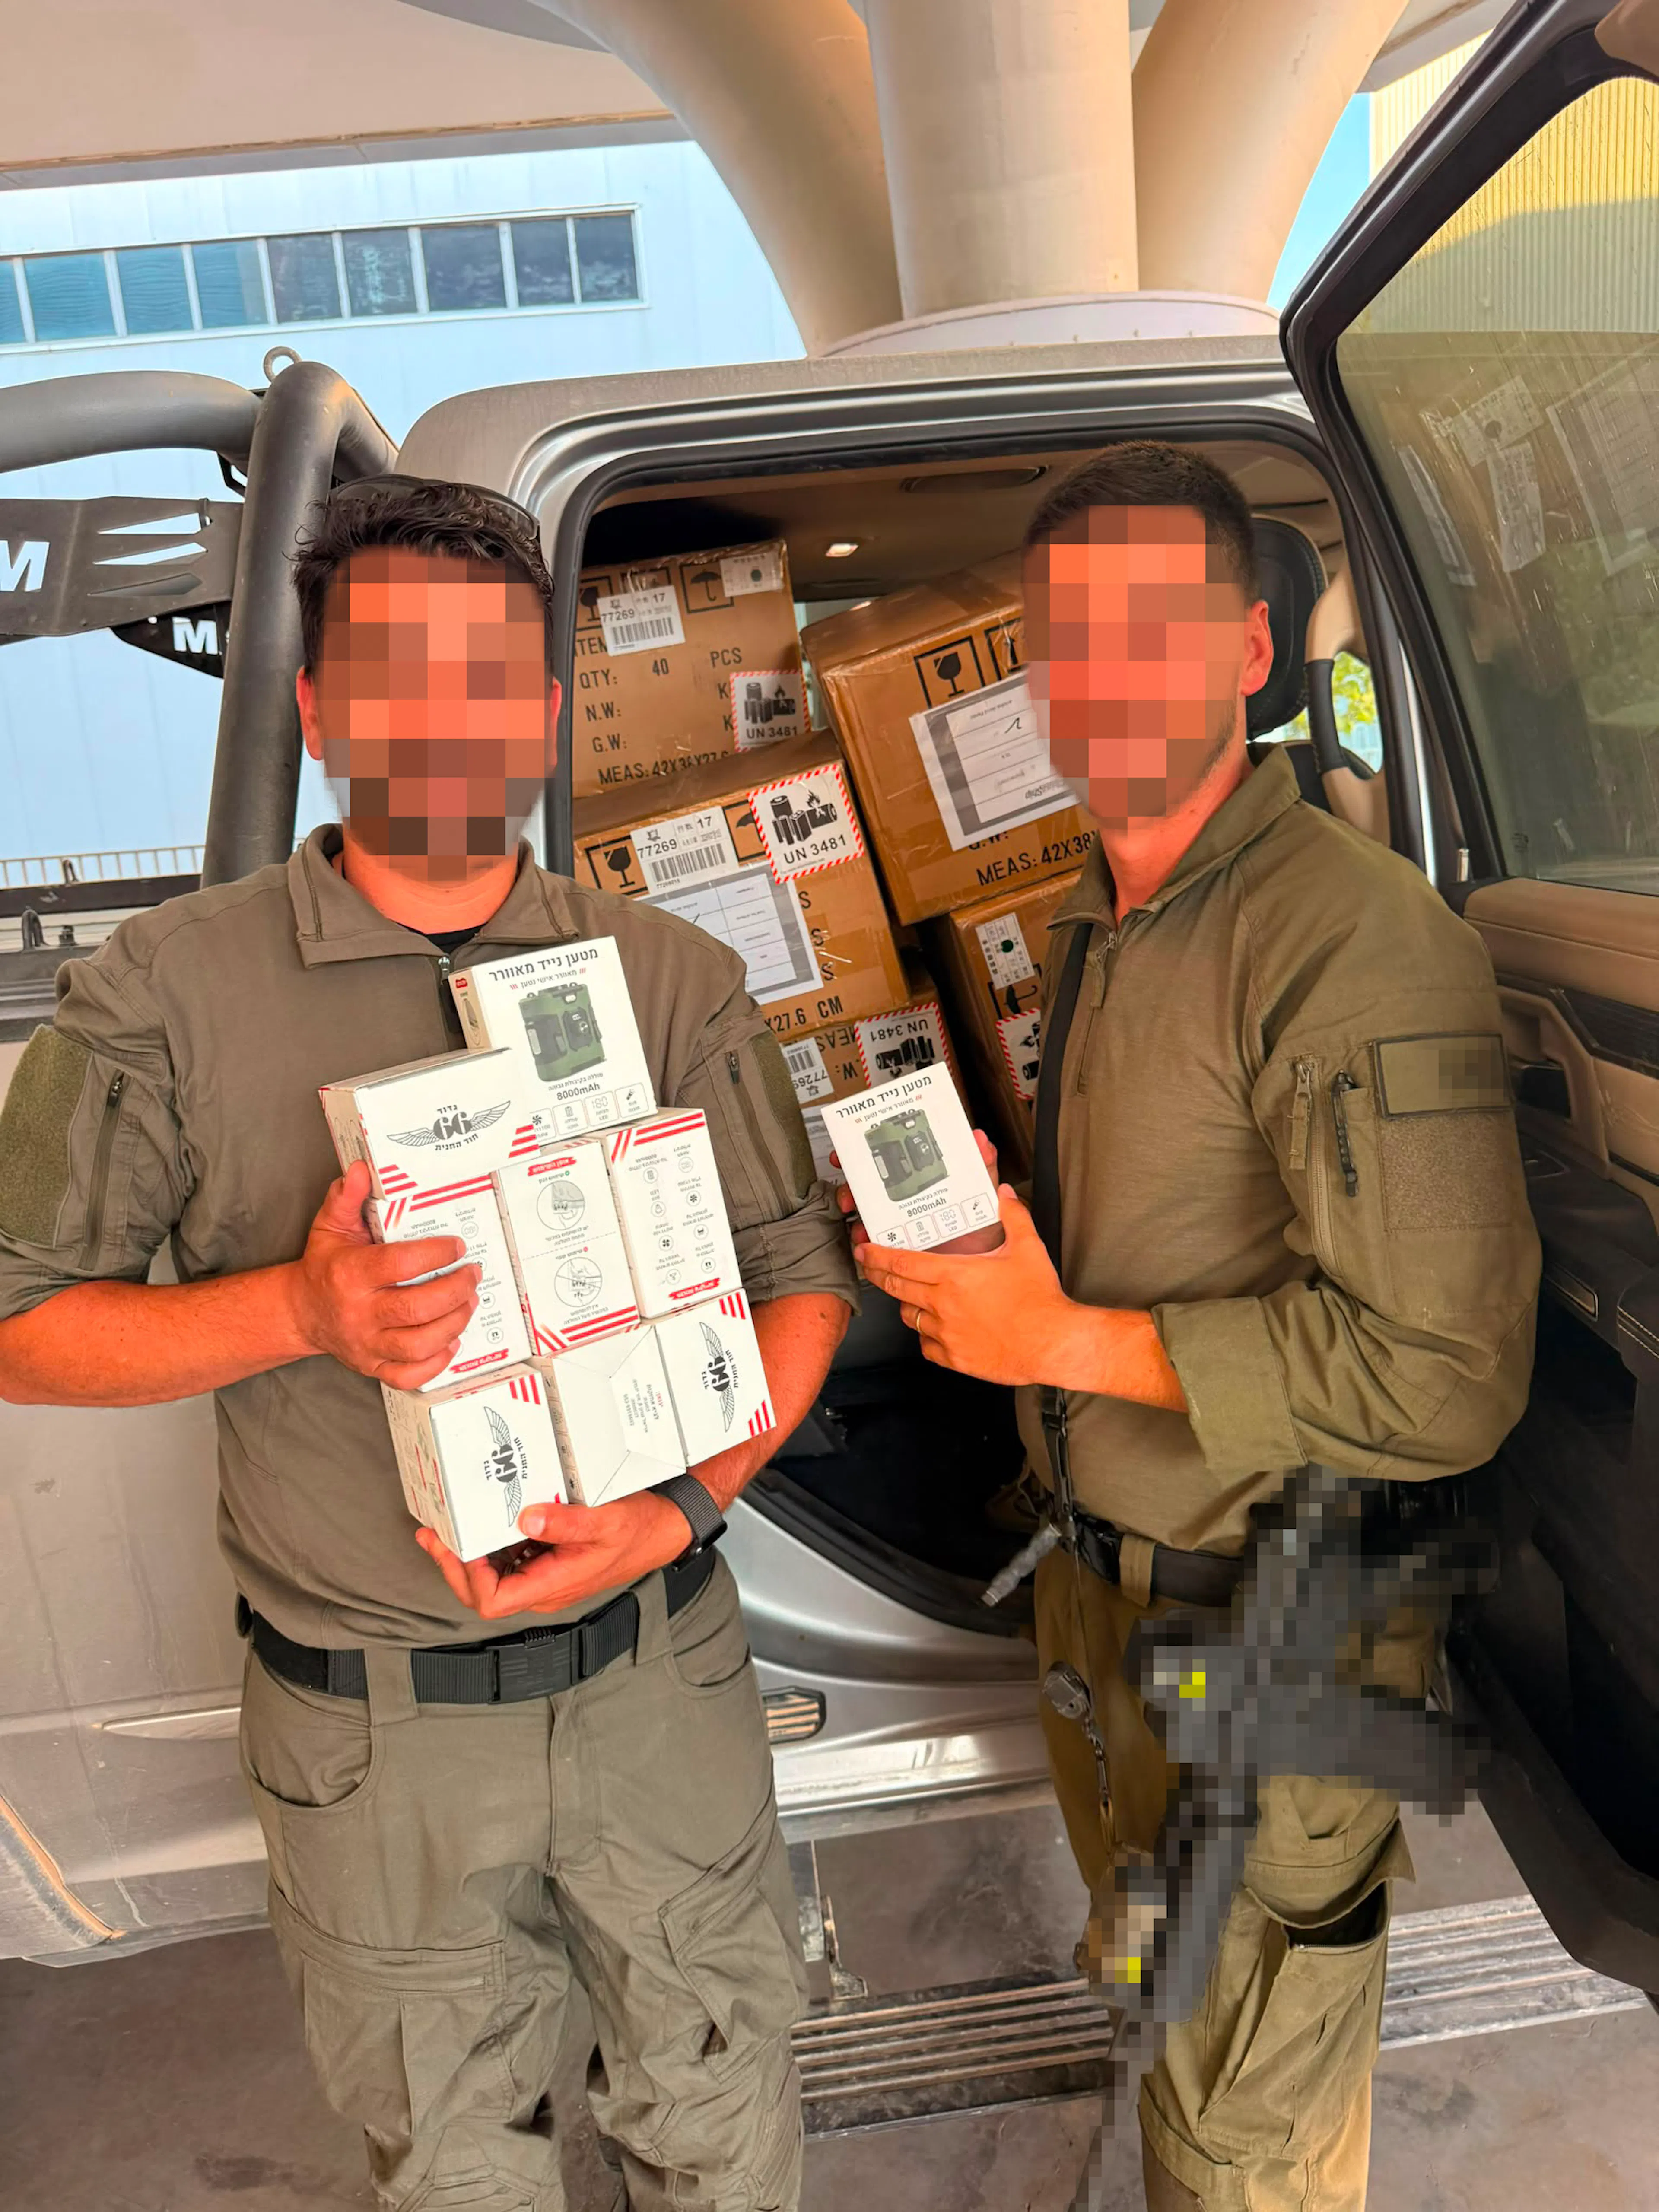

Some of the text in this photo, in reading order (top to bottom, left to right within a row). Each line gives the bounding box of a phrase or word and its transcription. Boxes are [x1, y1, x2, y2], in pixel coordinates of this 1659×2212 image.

[653, 592, 666, 603] 17
[602, 609, 635, 623] 77269
[580, 647, 742, 690] QTY: 40 PCS
[586, 701, 621, 722] N.W:
[593, 733, 627, 753] G.W:
[746, 726, 798, 739] UN 3481
[598, 762, 649, 785] MEAS:
[696, 816, 712, 829] 17
[637, 839, 678, 859] 77269
[783, 834, 847, 864] UN 3481
[976, 853, 1037, 887] MEAS:
[489, 949, 599, 981] מטען נייד מאוורר
[521, 969, 577, 989] מאוורר אישי נטען
[817, 995, 844, 1019] CM
[869, 1019, 929, 1042] UN 3481
[556, 1082, 600, 1100] 8000mAh
[836, 1076, 932, 1118] מטען נייד מאוורר
[437, 1105, 458, 1114] גדוד
[864, 1097, 914, 1122] מאוורר אישי נטען
[433, 1112, 472, 1140] 66
[435, 1133, 478, 1150] חוד החנית
[907, 1197, 947, 1217] 8000mAh
[708, 1356, 730, 1391] 66
[514, 1437, 523, 1452] חוד
[491, 1443, 518, 1482] 66
